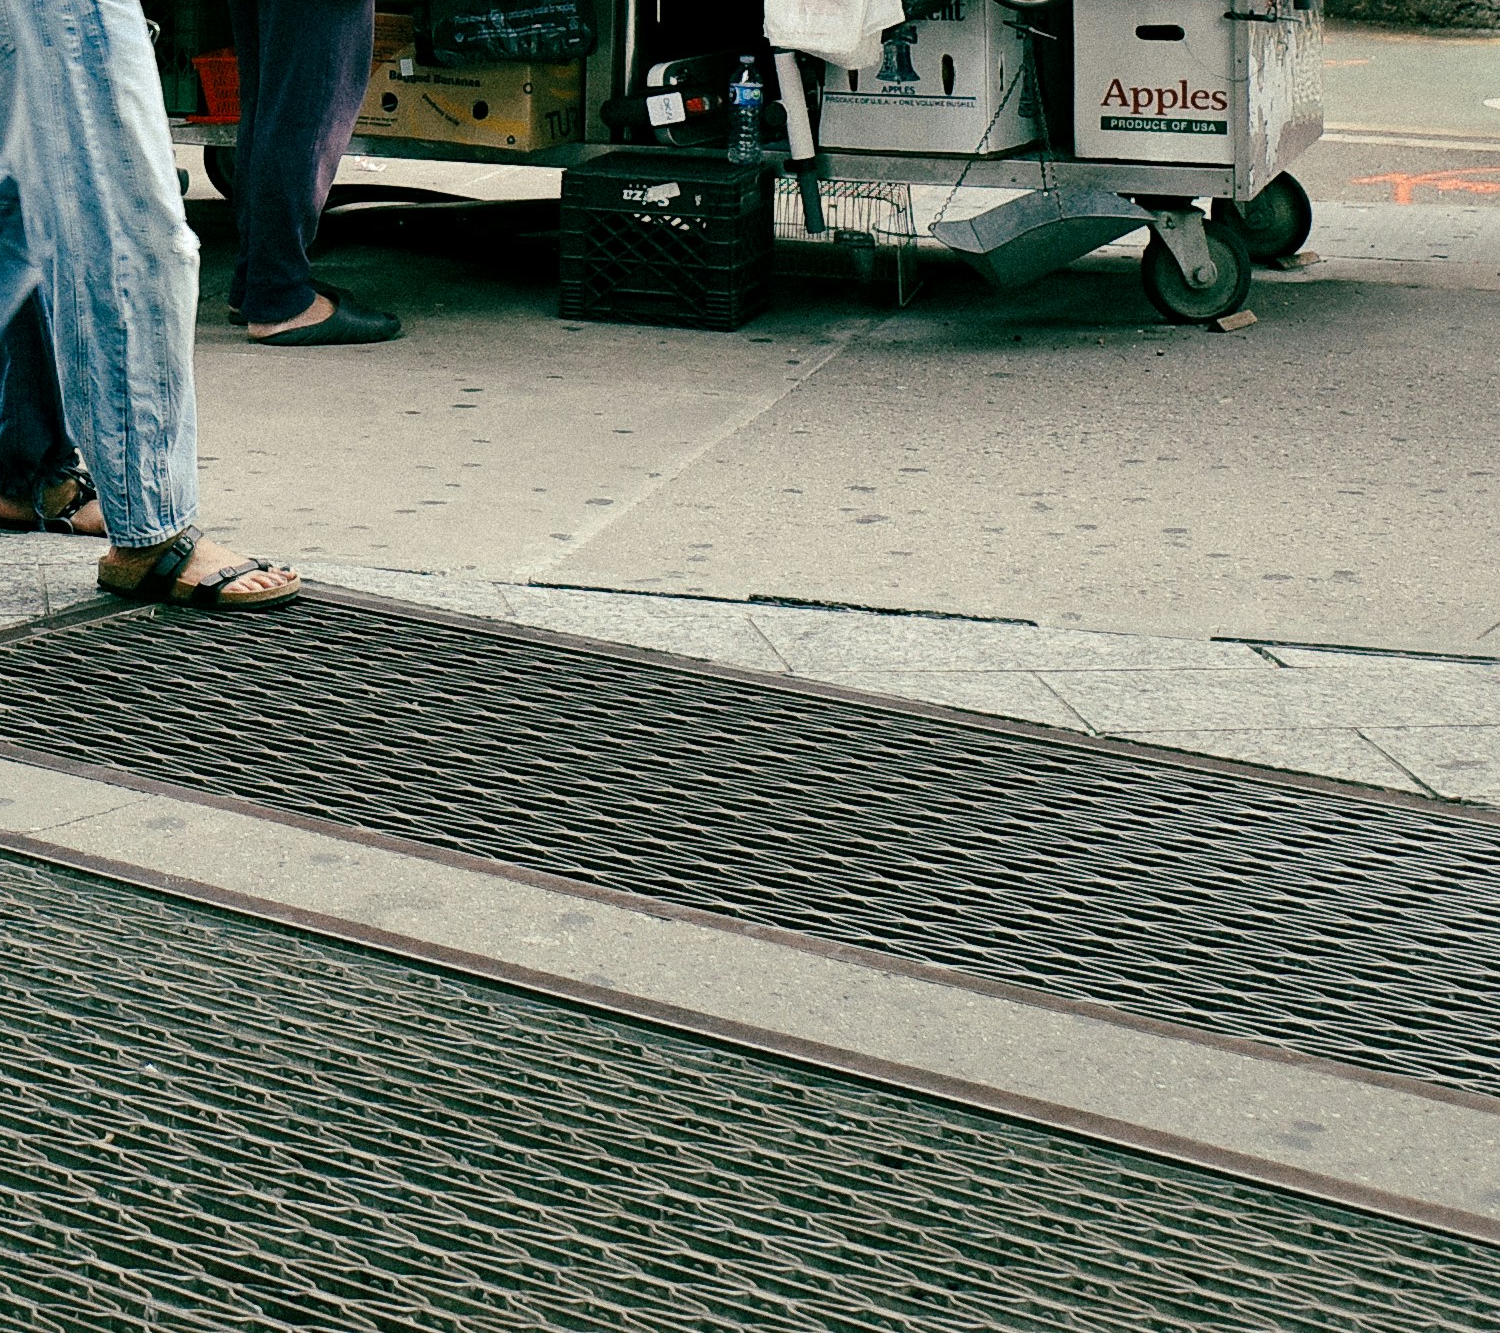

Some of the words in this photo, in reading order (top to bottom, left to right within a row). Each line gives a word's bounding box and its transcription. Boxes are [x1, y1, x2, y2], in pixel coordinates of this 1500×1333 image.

[882, 85, 915, 95] APPLES
[825, 96, 858, 105] PRODUCE
[915, 100, 945, 108] VOLUME
[1100, 78, 1228, 116] Apples
[1111, 119, 1167, 130] PRODUCE
[1172, 122, 1187, 131] OF
[1192, 122, 1216, 132] USA
